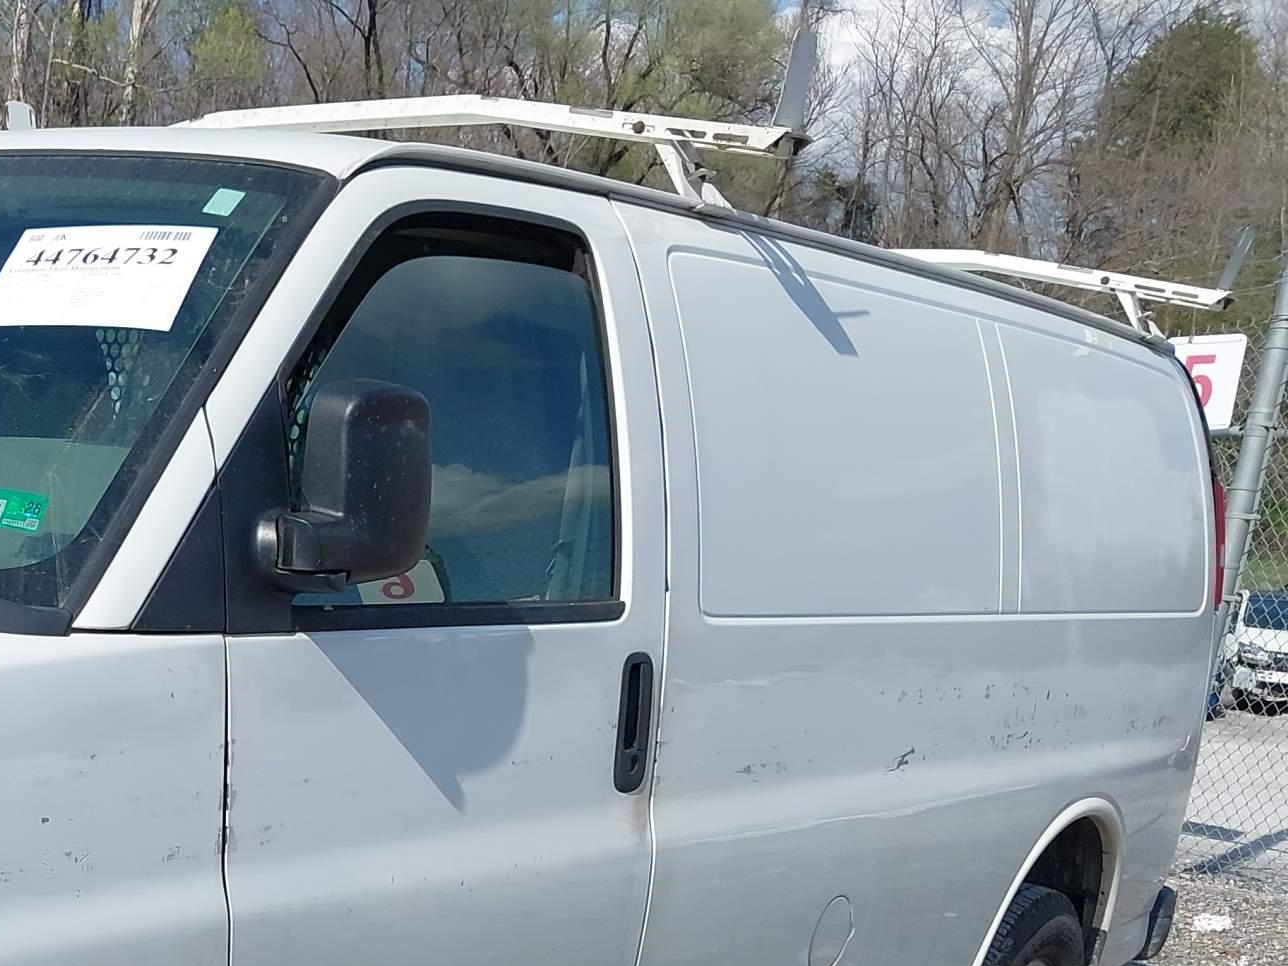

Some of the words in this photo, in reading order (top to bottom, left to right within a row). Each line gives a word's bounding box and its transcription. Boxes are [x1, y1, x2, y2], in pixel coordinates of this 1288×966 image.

[25, 247, 178, 266] 44764732
[1185, 354, 1216, 409] 5
[24, 501, 43, 515] 26
